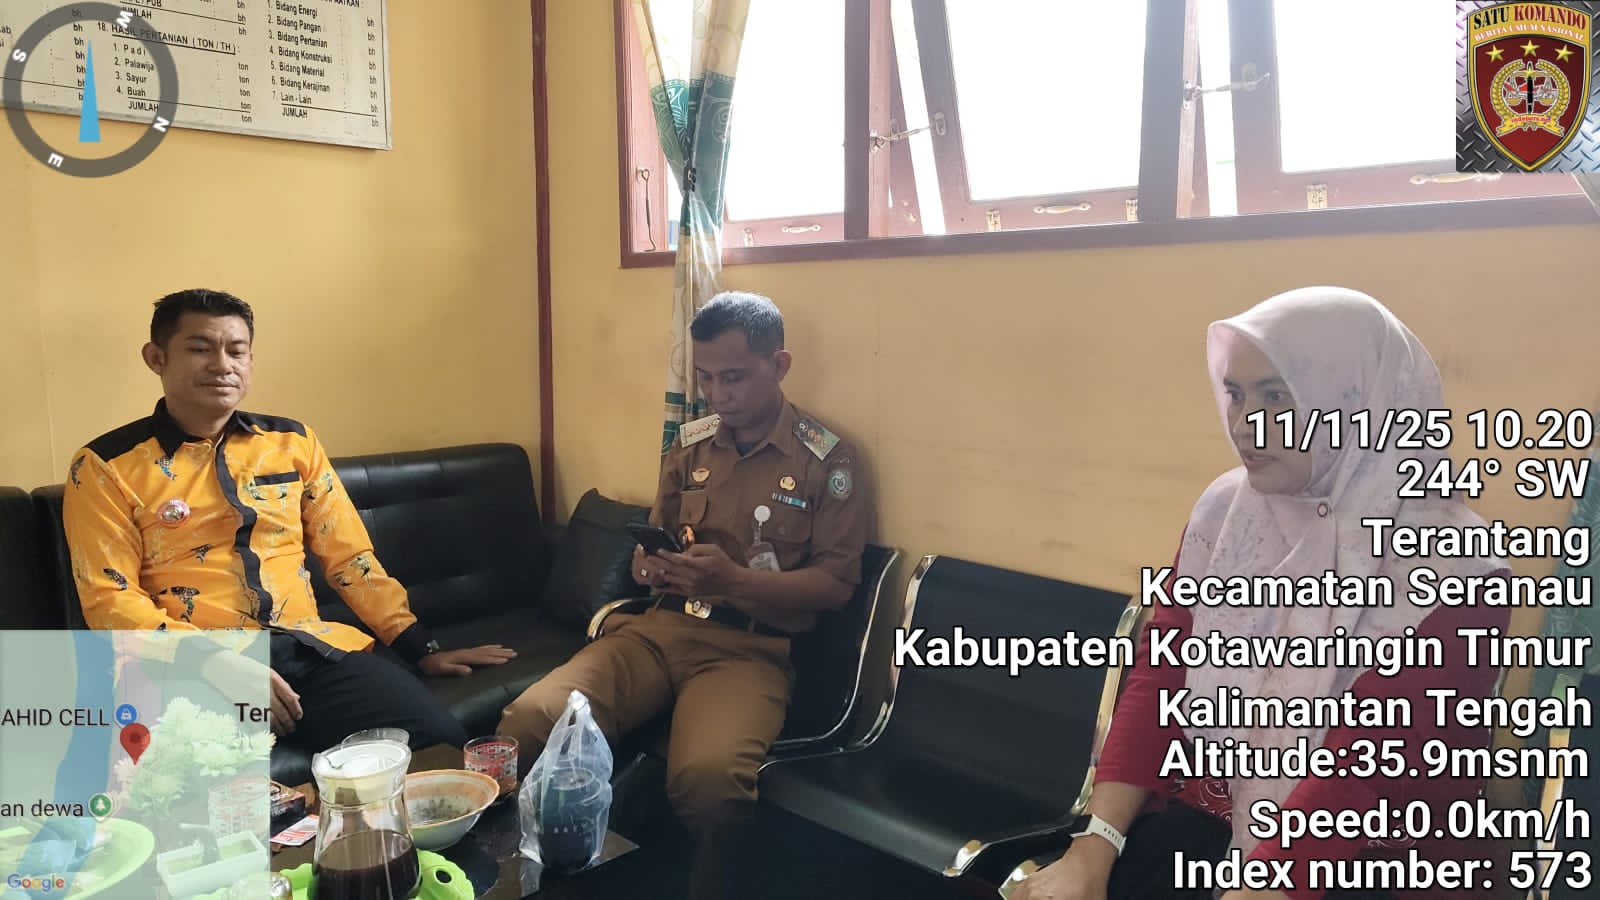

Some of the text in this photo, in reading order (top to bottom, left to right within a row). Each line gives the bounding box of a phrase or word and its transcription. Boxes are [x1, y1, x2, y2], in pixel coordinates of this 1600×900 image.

[276, 0, 298, 15] Bidang
[299, 5, 318, 19] Energi
[276, 16, 298, 30] Bidang
[299, 20, 322, 33] Pangan
[277, 31, 299, 45] Bidang
[300, 34, 328, 49] Pertanian
[278, 46, 300, 60] Bidang
[300, 49, 333, 64] Konstruksi
[125, 58, 154, 73] Palawija
[279, 61, 301, 76] Bidang
[301, 64, 325, 77] Material
[126, 72, 147, 84] Sayur
[280, 77, 301, 91] Bidang
[302, 80, 331, 94] Kerajinan
[127, 86, 146, 97] Buah
[128, 100, 160, 112] JUMLAH
[281, 107, 308, 118] JUMLAH
